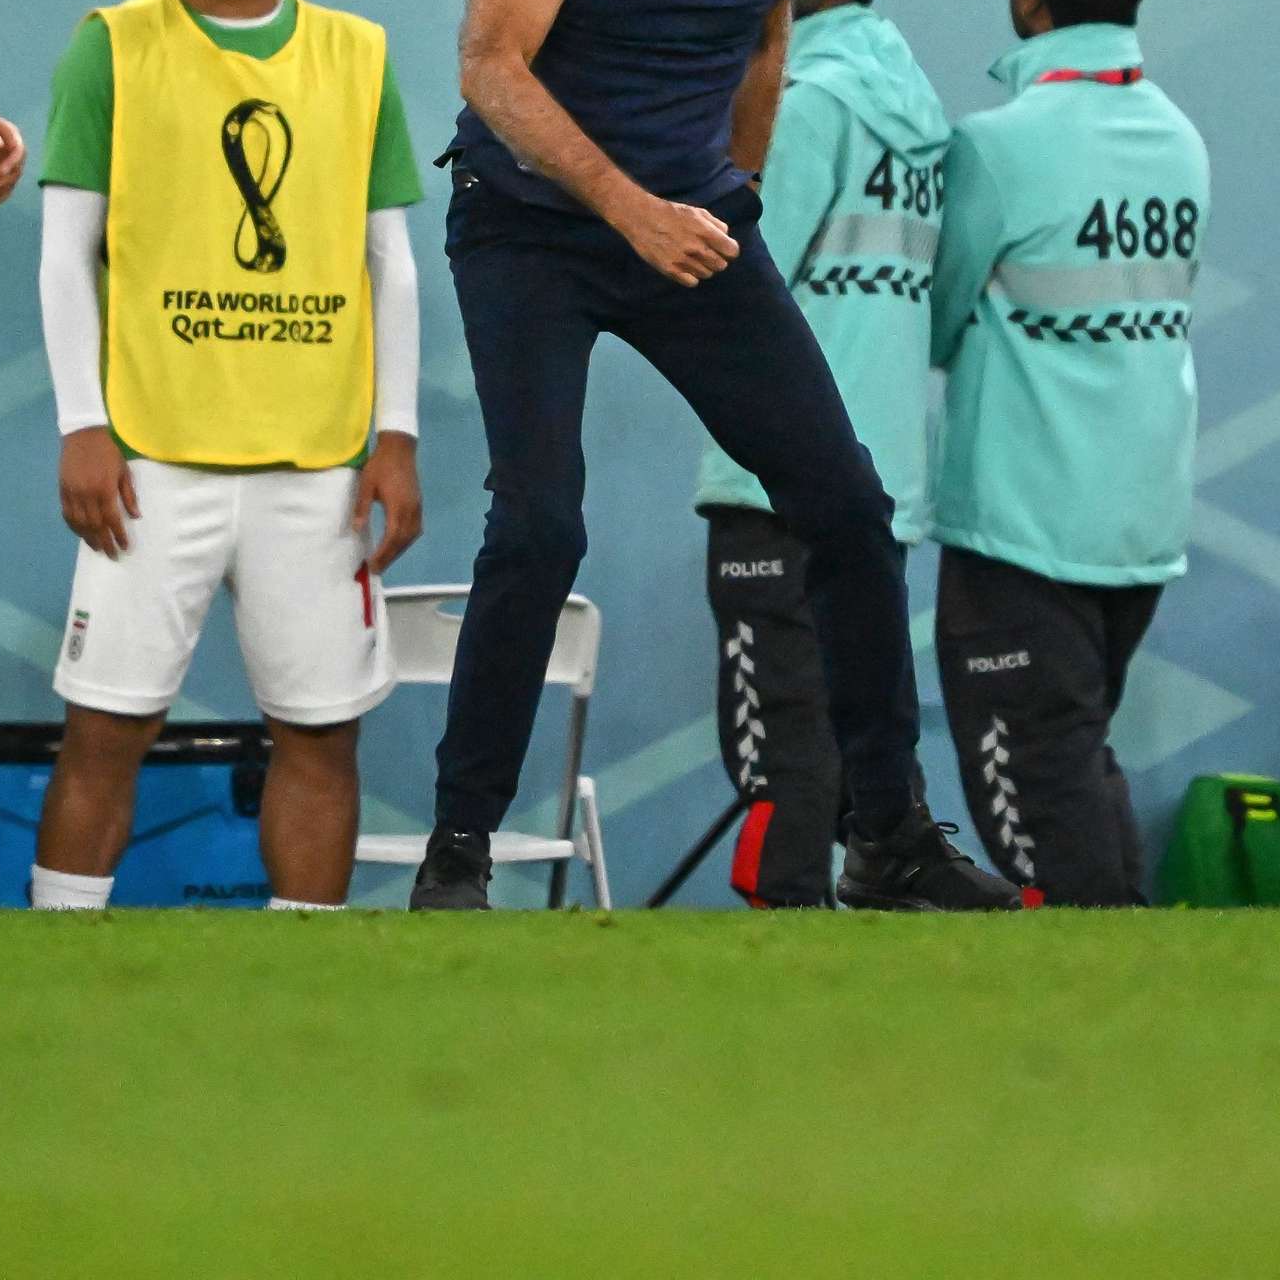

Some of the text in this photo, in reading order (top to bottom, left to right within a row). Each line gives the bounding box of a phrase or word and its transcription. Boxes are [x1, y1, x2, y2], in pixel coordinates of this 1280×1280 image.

[1077, 197, 1198, 259] 4688
[163, 291, 346, 315] FIFA WORLD CUP
[720, 560, 784, 578] POLICE
[967, 650, 1031, 673] POLICE
